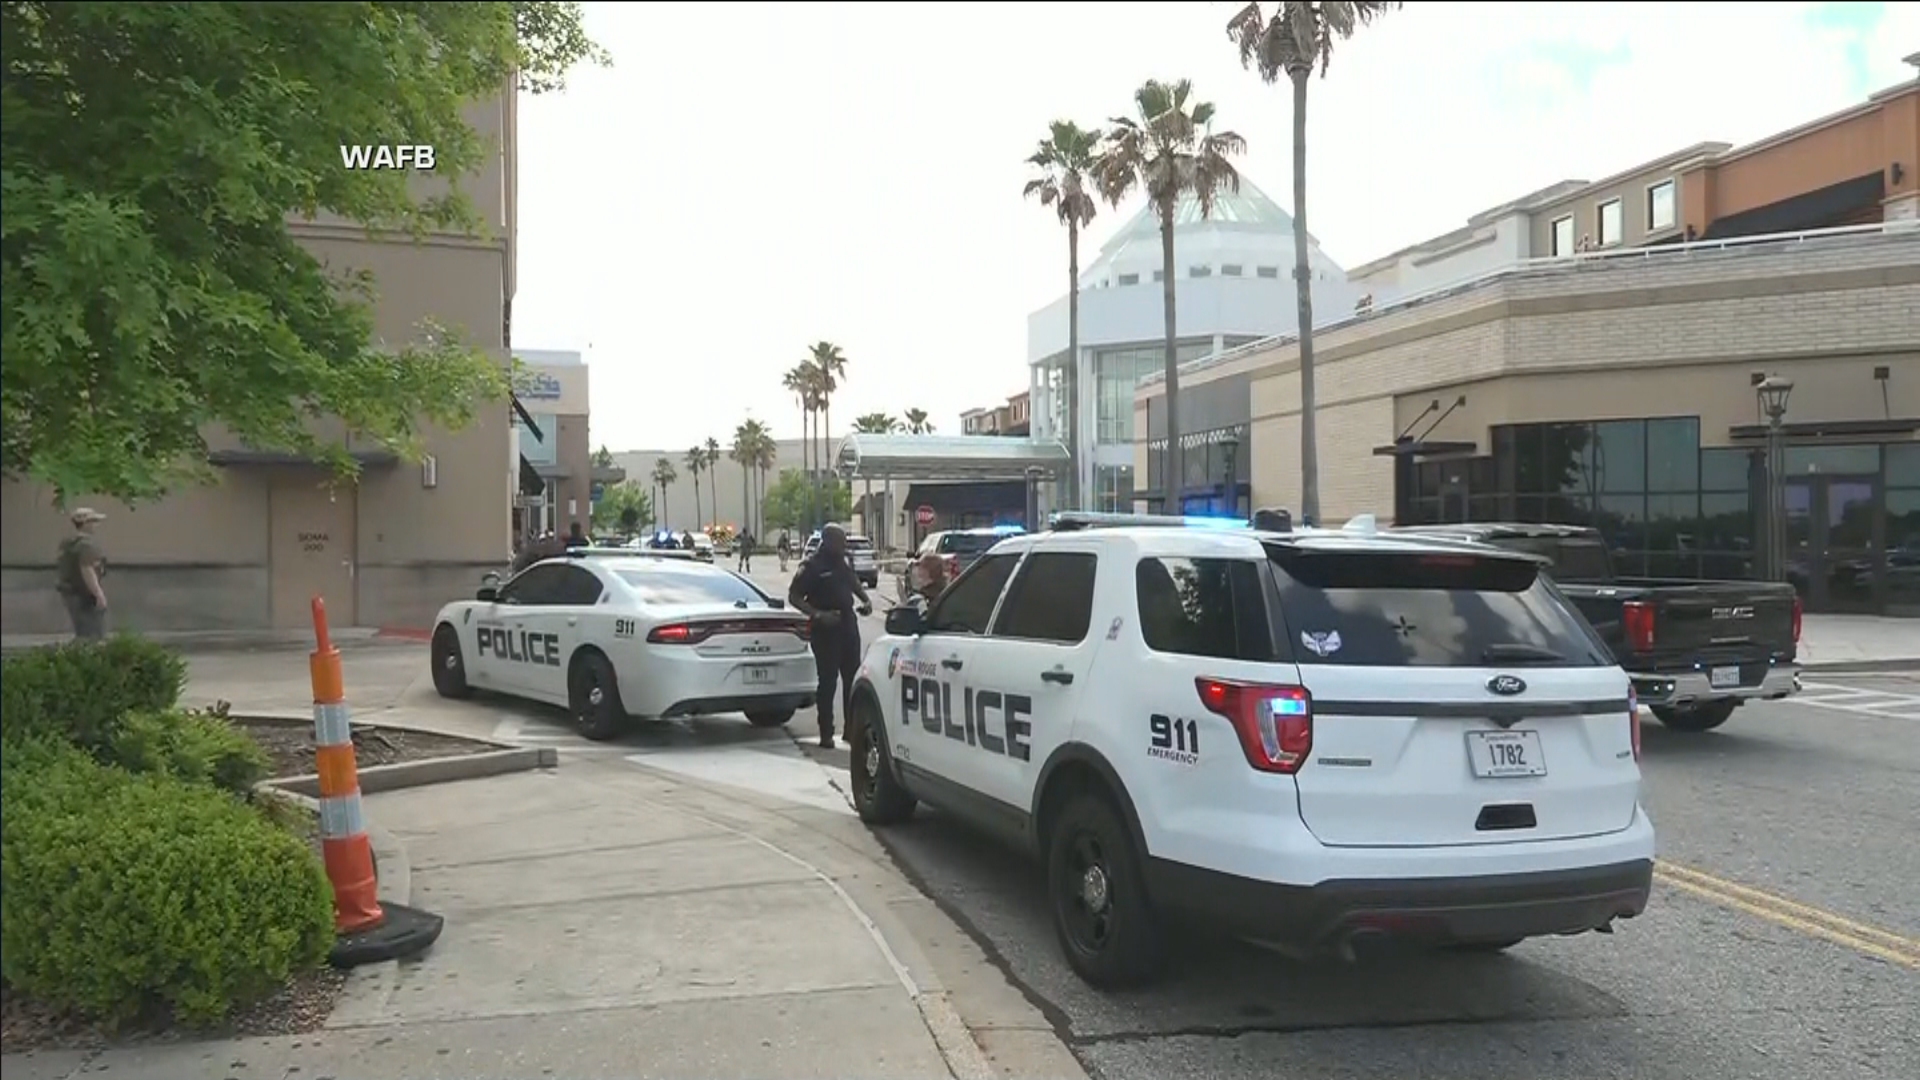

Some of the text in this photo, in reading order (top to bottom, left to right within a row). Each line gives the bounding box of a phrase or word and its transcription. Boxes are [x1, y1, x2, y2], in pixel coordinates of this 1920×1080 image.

[917, 510, 934, 521] STOP
[615, 619, 635, 635] 911
[477, 627, 561, 667] POLICE
[919, 660, 937, 677] ROUGE
[1496, 677, 1521, 692] Ford
[901, 674, 1032, 762] POLICE
[1150, 713, 1199, 754] 911
[1147, 746, 1198, 765] EMERGENCY
[1488, 743, 1527, 766] 1782
